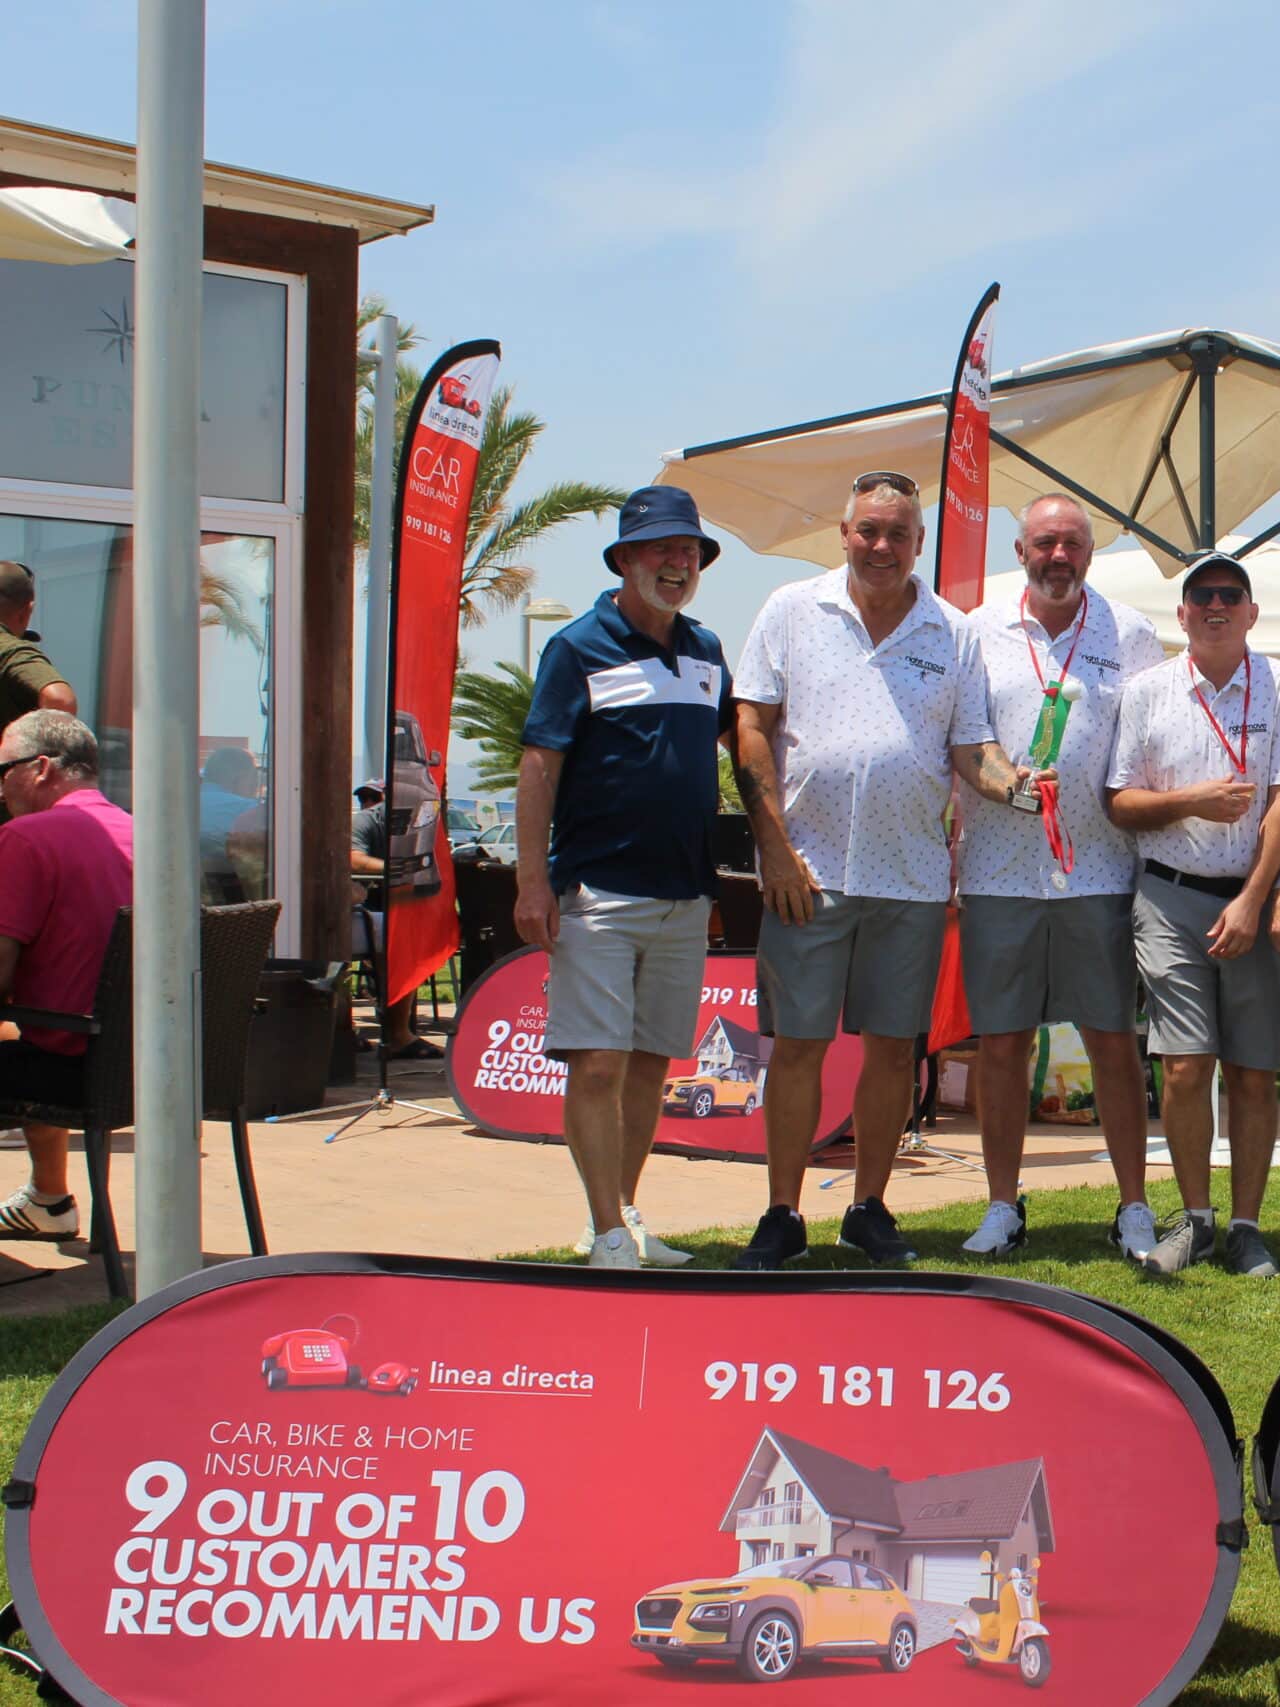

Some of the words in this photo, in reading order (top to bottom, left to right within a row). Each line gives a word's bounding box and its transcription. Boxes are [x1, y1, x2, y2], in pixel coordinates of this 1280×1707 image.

[413, 446, 461, 494] CAR
[409, 479, 458, 508] INSURANCE
[406, 514, 422, 532] 919
[423, 521, 438, 537] 181
[700, 986, 734, 1005] 919
[740, 988, 758, 1006] 18
[488, 1019, 511, 1049] 9
[511, 1032, 546, 1054] OU
[516, 1019, 548, 1030] INSUR
[480, 1049, 569, 1077] CUSTOM
[474, 1069, 569, 1097] RECOMM
[430, 1361, 492, 1386] linea
[503, 1364, 594, 1390] directa
[704, 1361, 798, 1402] 919
[818, 1365, 895, 1406] 181
[924, 1369, 1011, 1412] 126
[210, 1421, 277, 1449] CAR,
[287, 1423, 345, 1447] BIKE
[354, 1425, 373, 1448] &
[384, 1426, 475, 1451] HOME
[204, 1452, 379, 1480] INSURANCE
[125, 1460, 188, 1533] 9
[196, 1488, 323, 1537] OUT
[335, 1493, 416, 1539] OF
[430, 1470, 526, 1544] 10
[114, 1537, 466, 1591] CUSTOMERS
[104, 1588, 500, 1641] RECOMMEND
[518, 1597, 596, 1644] US
